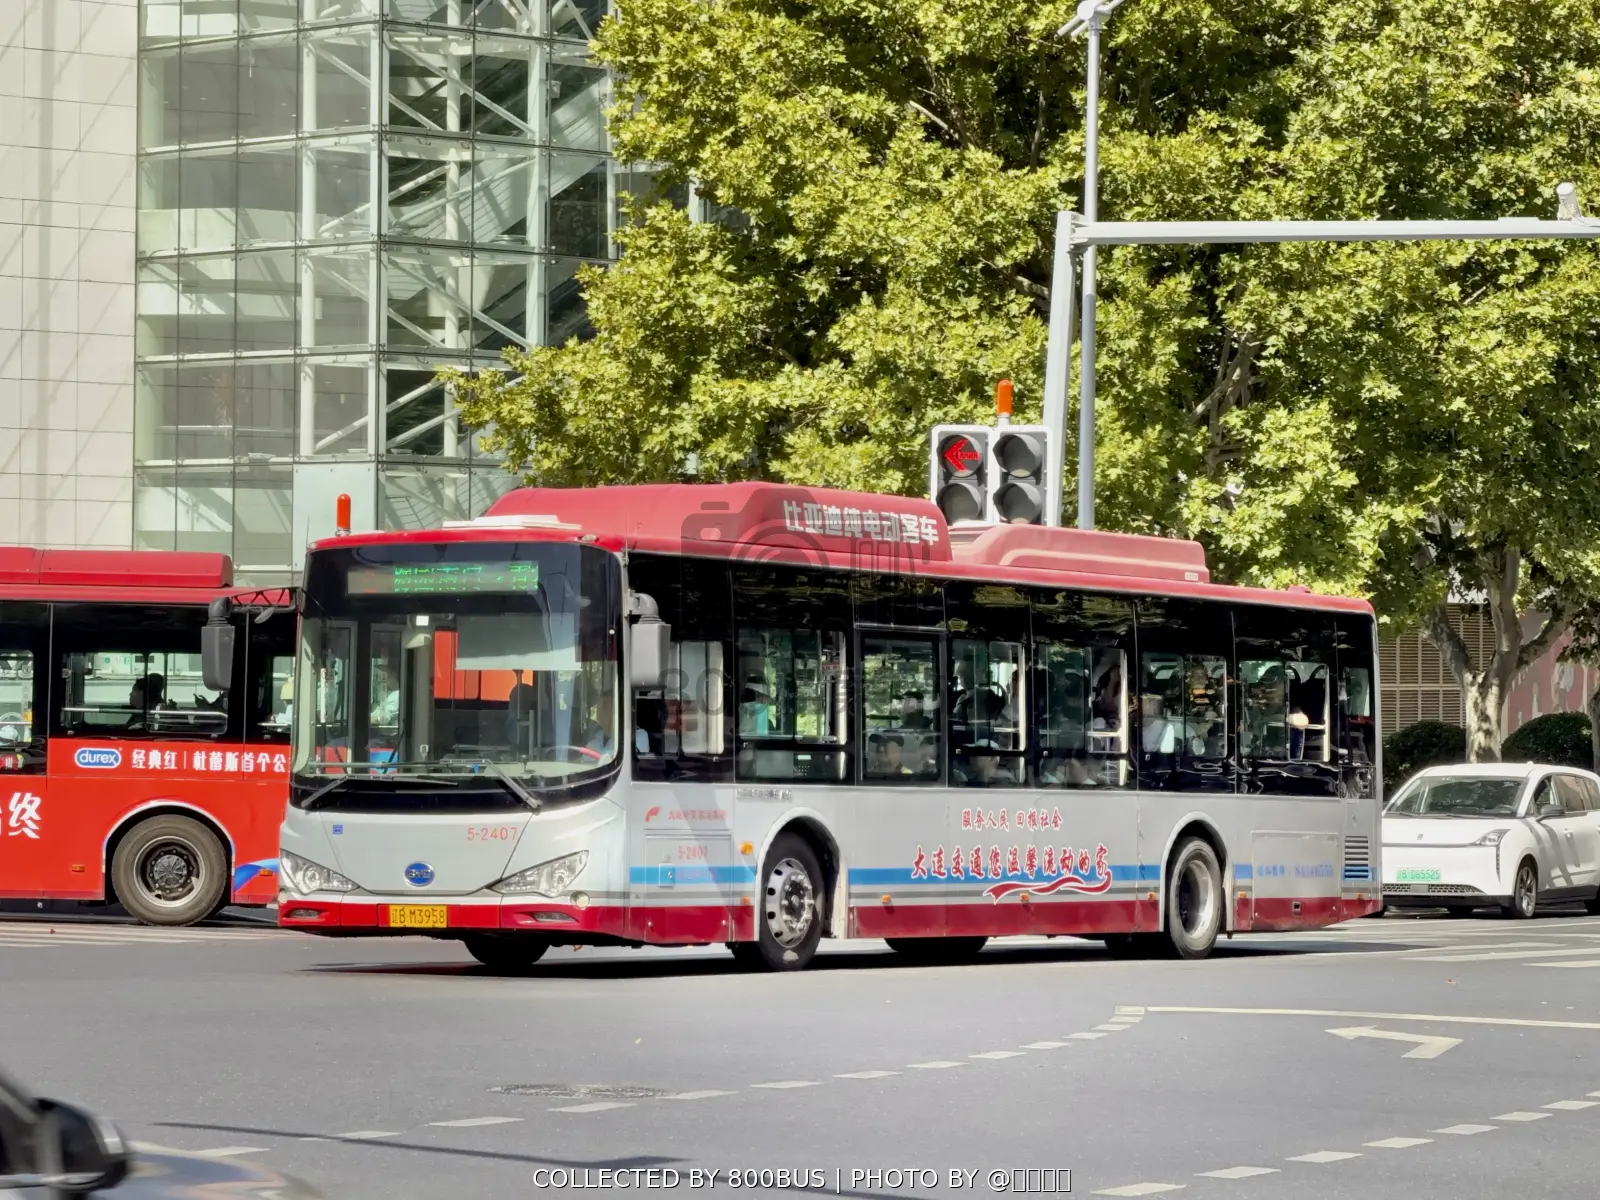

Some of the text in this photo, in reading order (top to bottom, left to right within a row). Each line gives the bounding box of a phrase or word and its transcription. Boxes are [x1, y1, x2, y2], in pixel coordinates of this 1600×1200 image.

[783, 500, 938, 545] 比亚迪纯电动客车
[78, 750, 117, 765] durex
[132, 749, 290, 772] 经典红 杜蕾斯首个公
[0, 792, 42, 839] 终
[962, 807, 1062, 831] 服务人民 回报社会
[467, 826, 518, 841] 5-2407
[911, 843, 1108, 880] 大连交通您温馨流动的家
